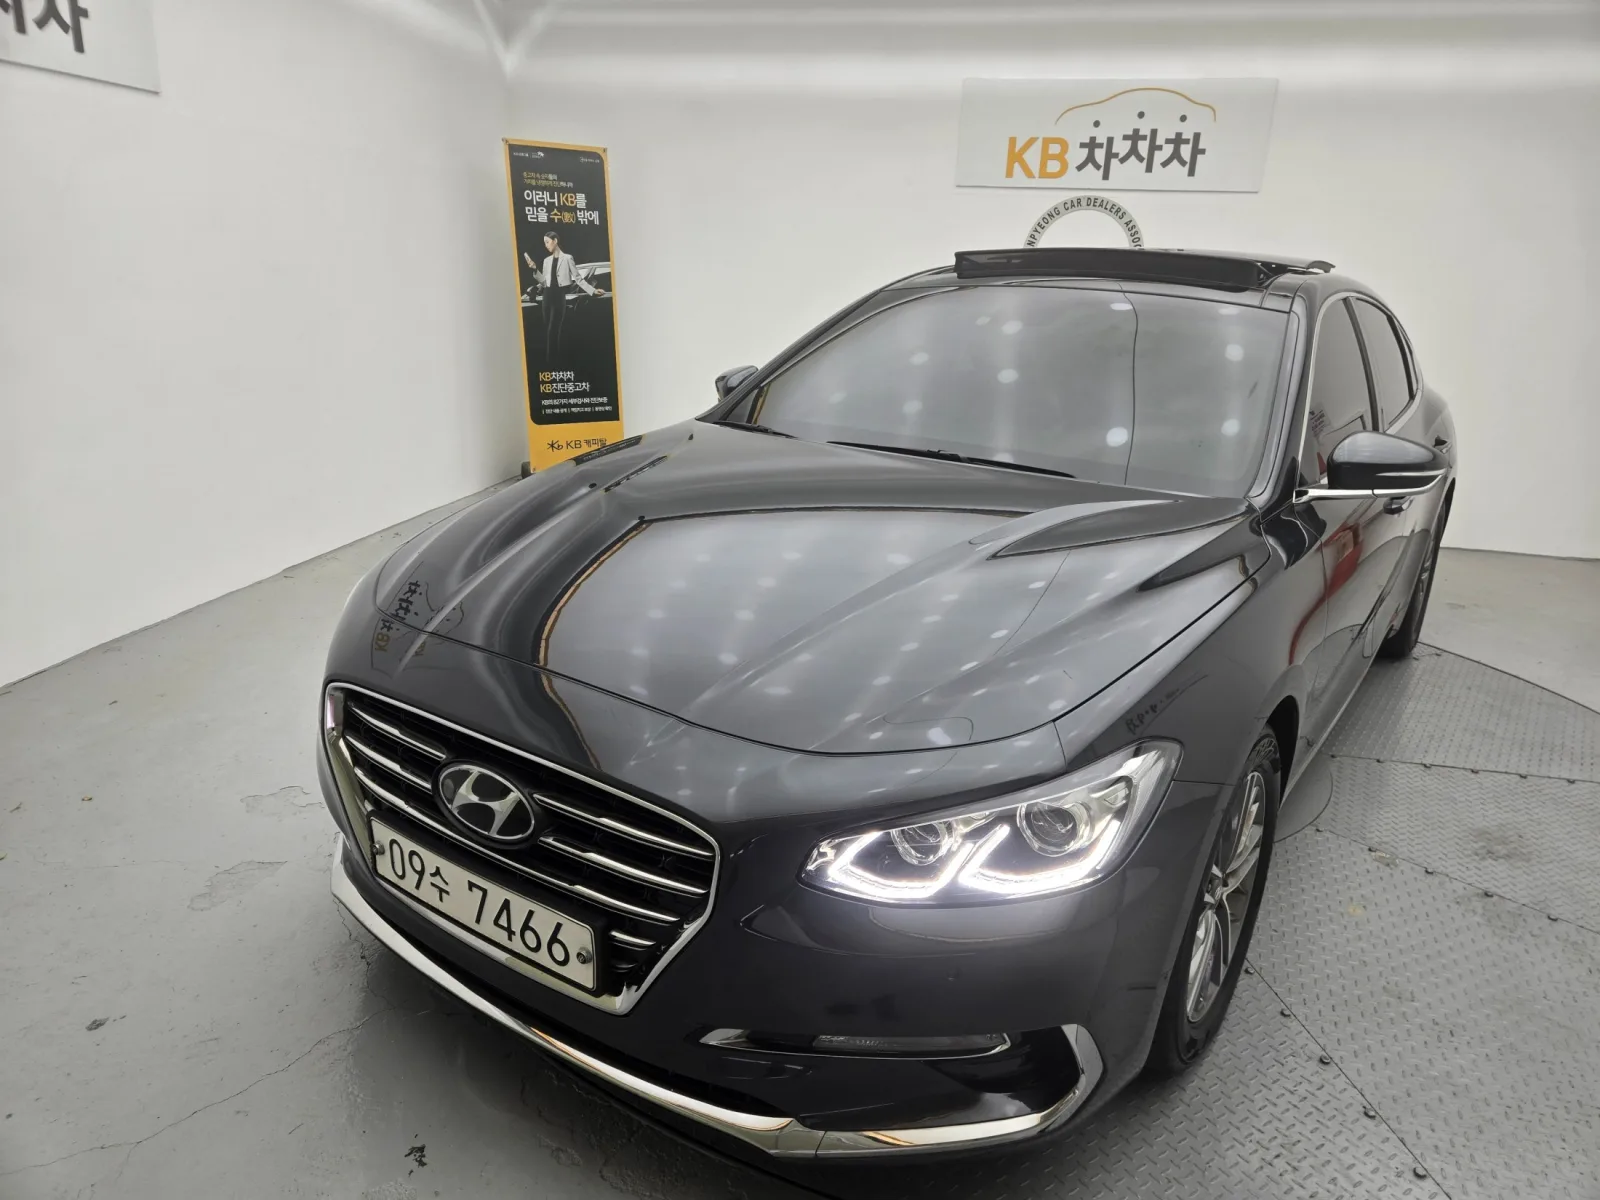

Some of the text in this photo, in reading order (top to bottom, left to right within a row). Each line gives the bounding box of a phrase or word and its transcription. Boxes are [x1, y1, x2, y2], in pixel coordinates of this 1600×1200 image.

[524, 190, 587, 208] 이러니 KB를
[525, 207, 548, 222] 믿을
[577, 210, 599, 225] 밖에
[1026, 207, 1061, 247] NPYEONG
[1063, 198, 1082, 211] CAR
[1086, 197, 1127, 220] DEALERS
[566, 440, 582, 450] KB
[388, 838, 570, 967] 09수 7466
